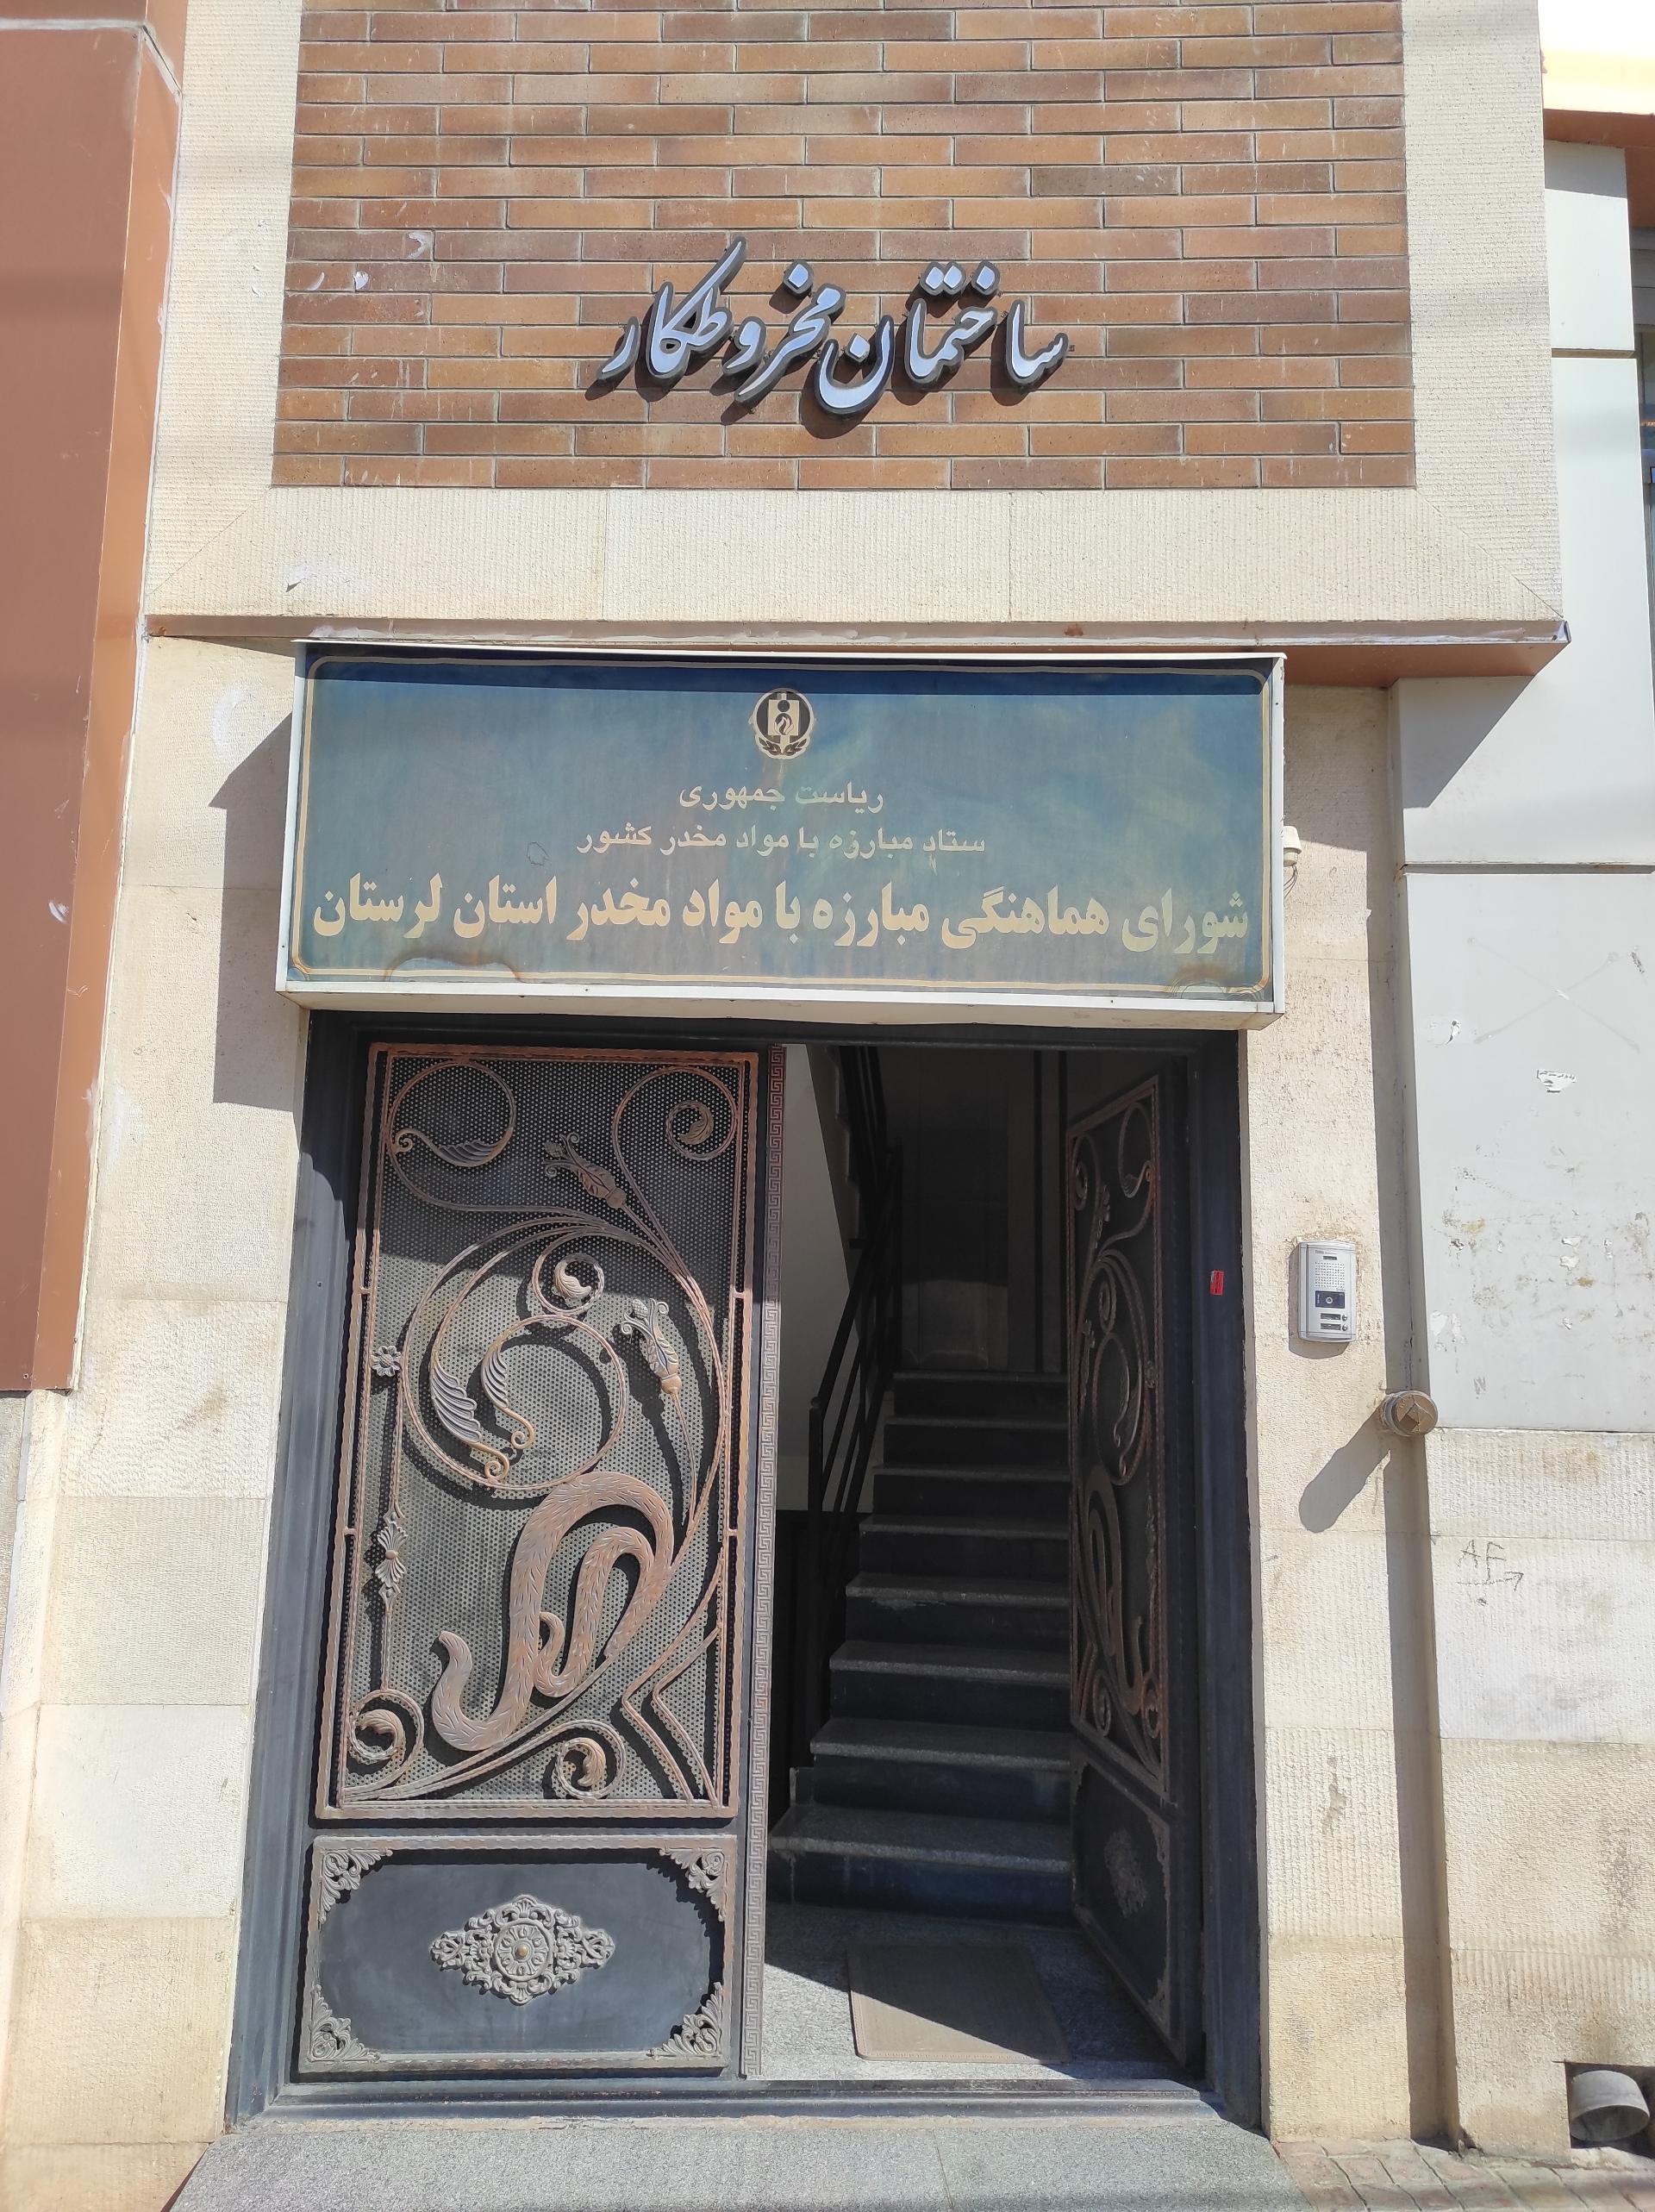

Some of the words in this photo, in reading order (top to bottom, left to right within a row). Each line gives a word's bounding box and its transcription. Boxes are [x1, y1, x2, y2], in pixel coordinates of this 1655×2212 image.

[813, 260, 1069, 416] ساختمان
[679, 782, 785, 811] جمهوری
[795, 782, 884, 814] ریاست
[576, 821, 652, 854] کشور
[659, 823, 728, 856] مخدر
[735, 824, 790, 858] مواد
[797, 826, 820, 859] با
[828, 827, 914, 859] مبارزه
[922, 828, 986, 853] ستاد
[313, 872, 444, 938] لرستان
[453, 874, 558, 939] استان
[565, 877, 671, 941] مخدر
[682, 878, 764, 944] مواد
[775, 879, 801, 946] با
[812, 880, 930, 947] مبارزه
[941, 884, 1110, 949] هماهنگی
[1121, 887, 1249, 954] شورای
